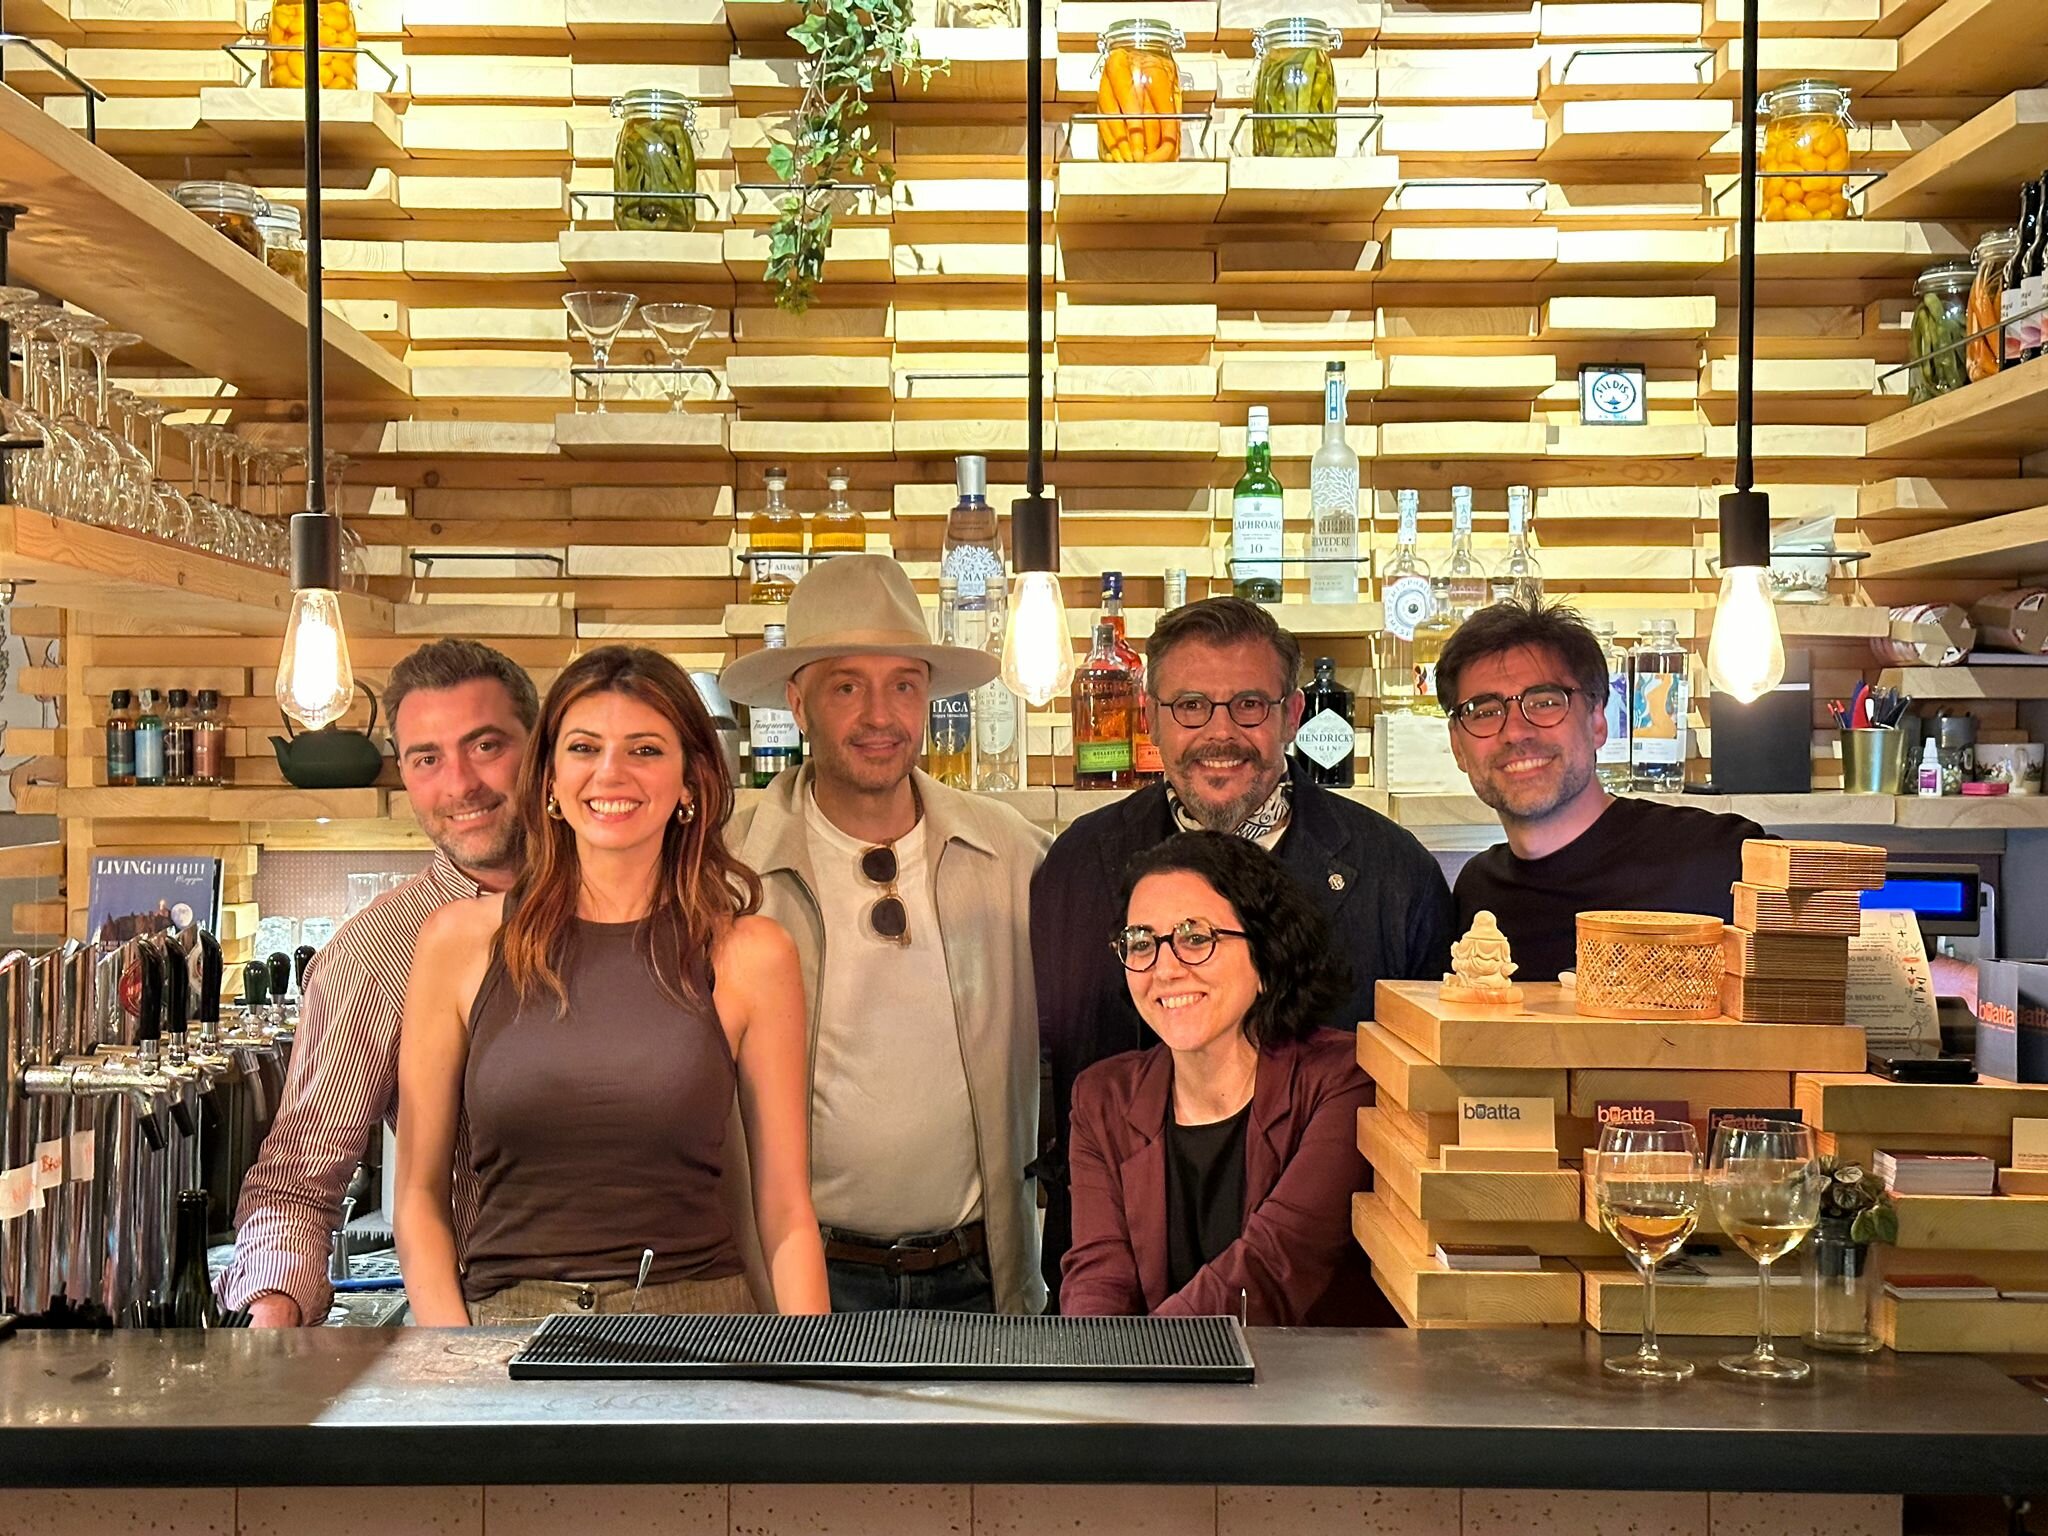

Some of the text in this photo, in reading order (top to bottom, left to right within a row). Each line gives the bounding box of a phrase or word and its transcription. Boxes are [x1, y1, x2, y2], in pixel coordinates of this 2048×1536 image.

[1312, 536, 1350, 547] ELVEDERE
[1250, 543, 1263, 554] 10
[932, 698, 968, 713] ITACA
